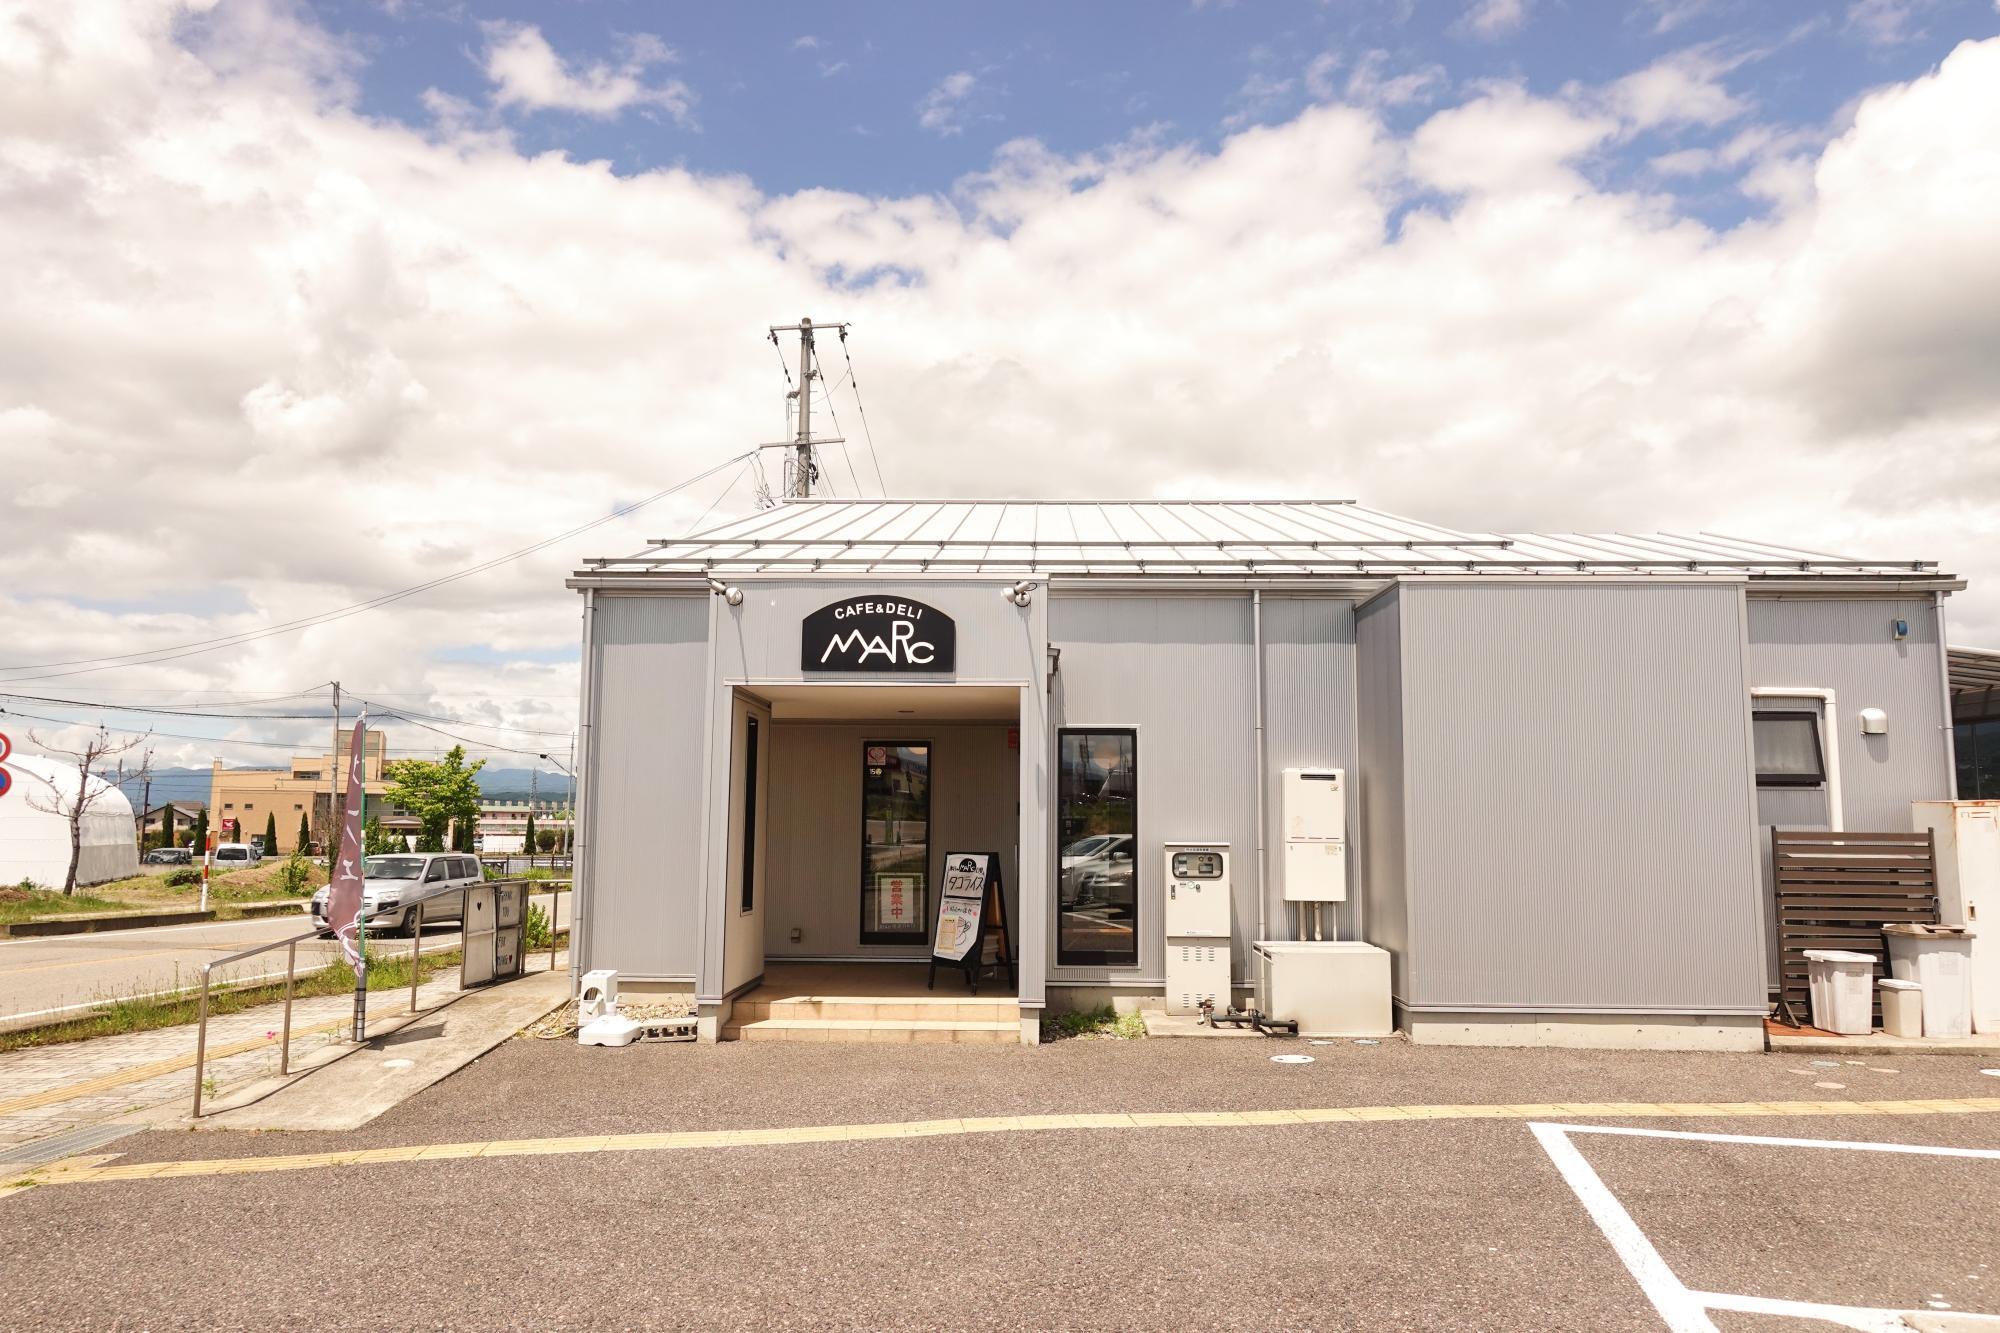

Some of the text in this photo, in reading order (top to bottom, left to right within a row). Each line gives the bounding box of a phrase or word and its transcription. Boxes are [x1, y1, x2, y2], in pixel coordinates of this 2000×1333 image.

[834, 602, 923, 620] CAFE&DELI
[948, 876, 984, 892] タコライス
[890, 879, 903, 920] 営業中
